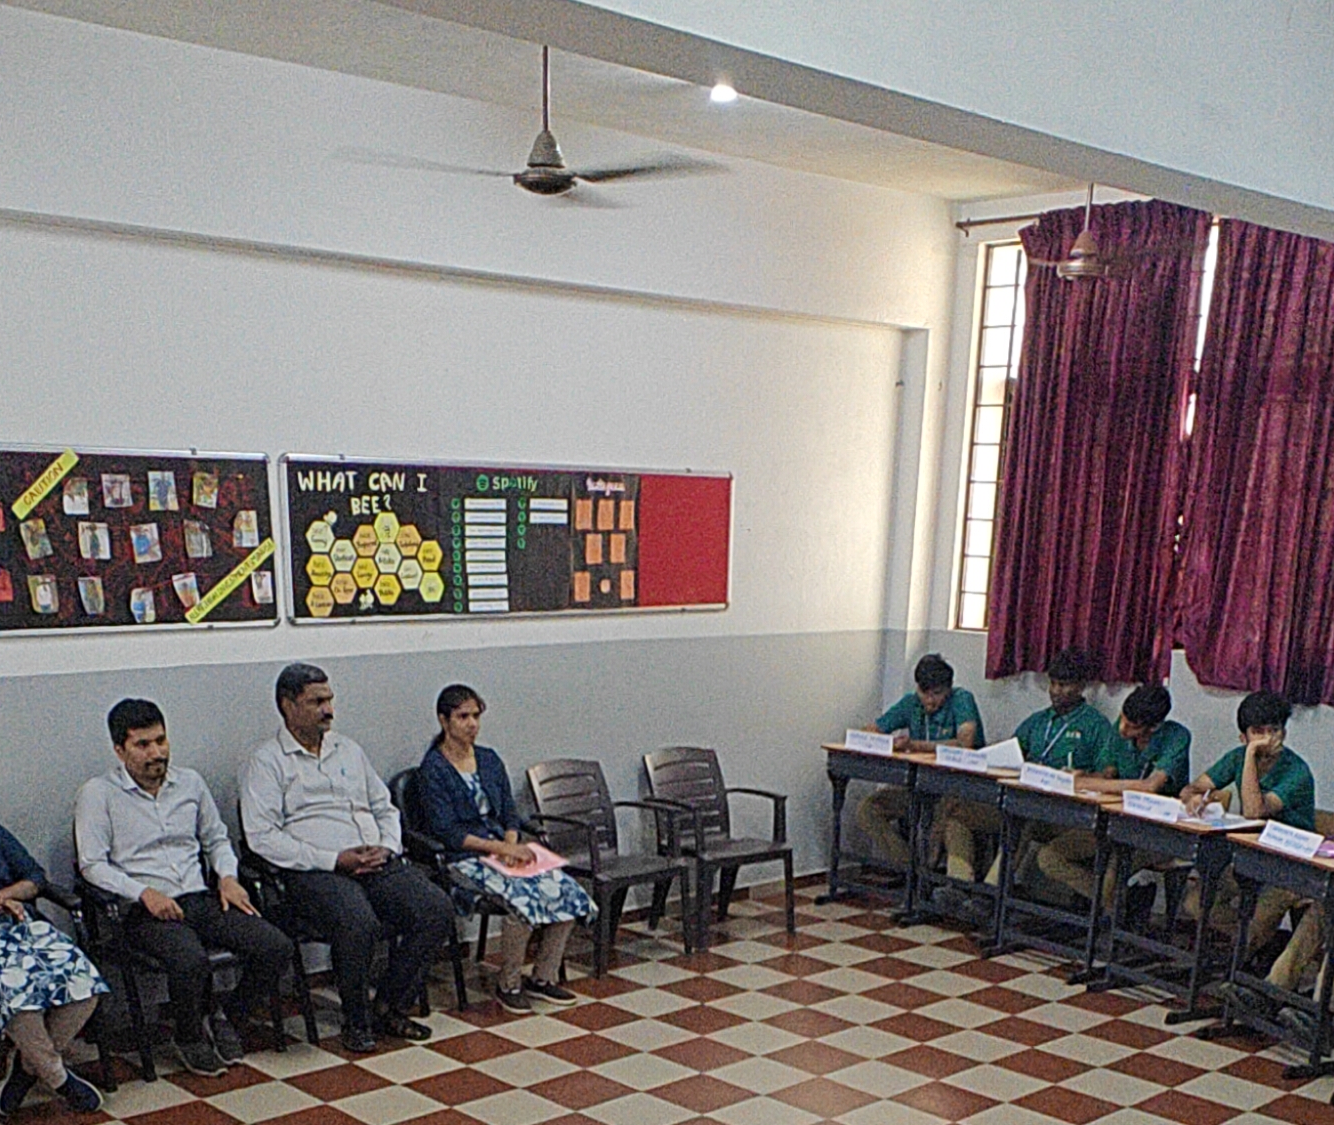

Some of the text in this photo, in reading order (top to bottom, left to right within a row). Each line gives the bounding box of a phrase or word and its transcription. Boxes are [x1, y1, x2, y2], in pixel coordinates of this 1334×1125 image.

[23, 462, 64, 506] CAUTION
[297, 470, 427, 493] WHAT CAN I
[492, 475, 538, 492] Spotify
[350, 494, 392, 516] BEE?
